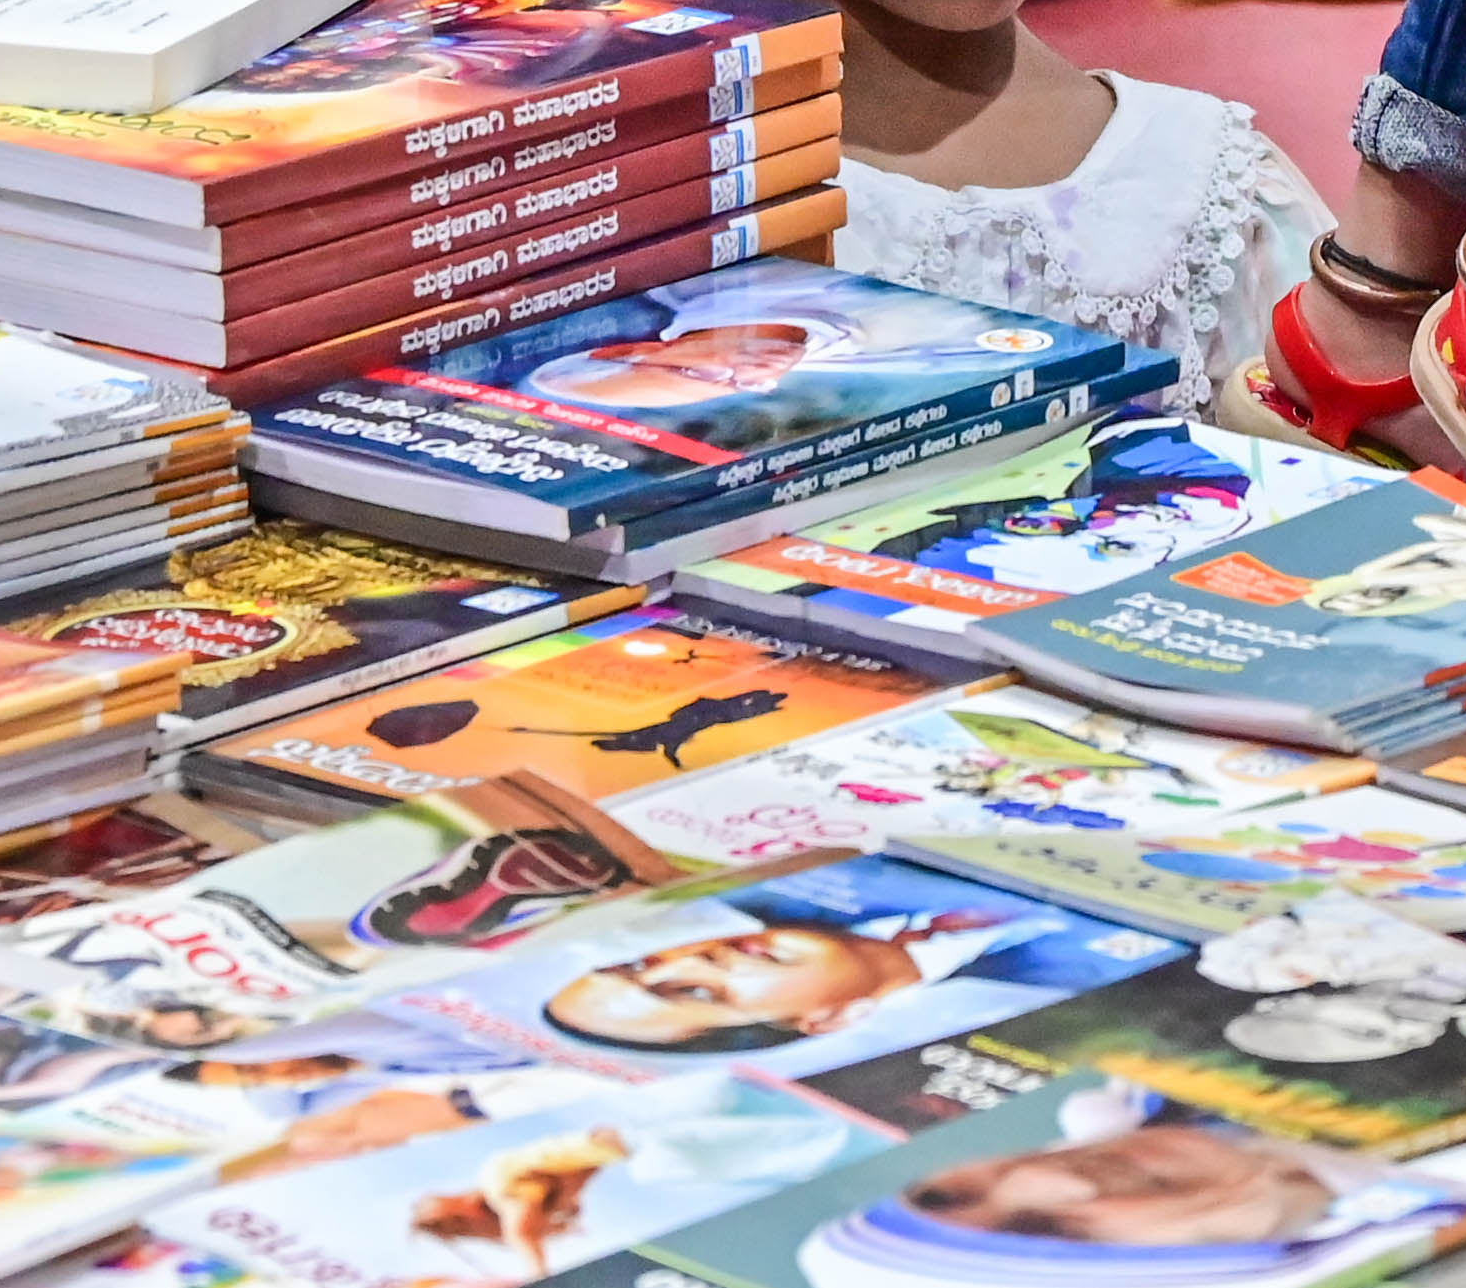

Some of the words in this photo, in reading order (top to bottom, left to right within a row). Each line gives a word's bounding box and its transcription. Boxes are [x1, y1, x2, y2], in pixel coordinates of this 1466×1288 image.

[513, 77, 620, 127] ಮಹಾಭಾರತ
[513, 119, 616, 171] ಮಹಾಭಾರತ
[515, 166, 619, 218] ಮಹಾಭಾರತ
[516, 211, 619, 265] ಮಹಾಭಾರತ
[509, 267, 616, 321] ಮಹಾಭಾರತ
